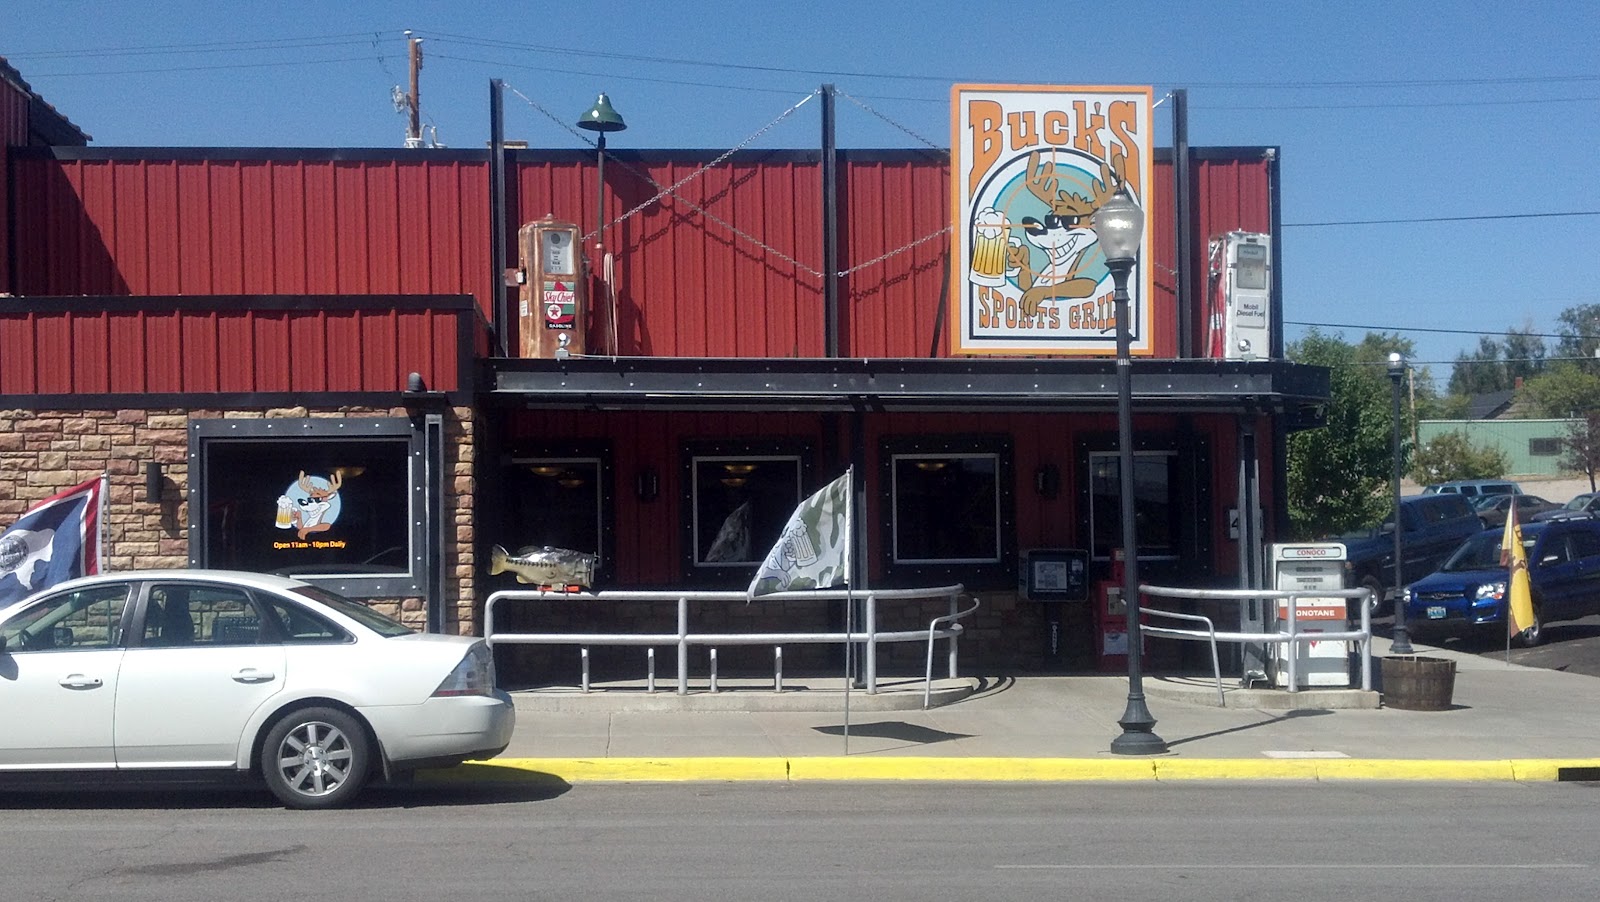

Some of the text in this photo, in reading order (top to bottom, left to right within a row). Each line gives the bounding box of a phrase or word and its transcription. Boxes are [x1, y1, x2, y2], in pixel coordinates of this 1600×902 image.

[978, 286, 1132, 330] SPORTS GRIL
[330, 541, 346, 549] Daily
[1295, 609, 1335, 617] ONOTANE
